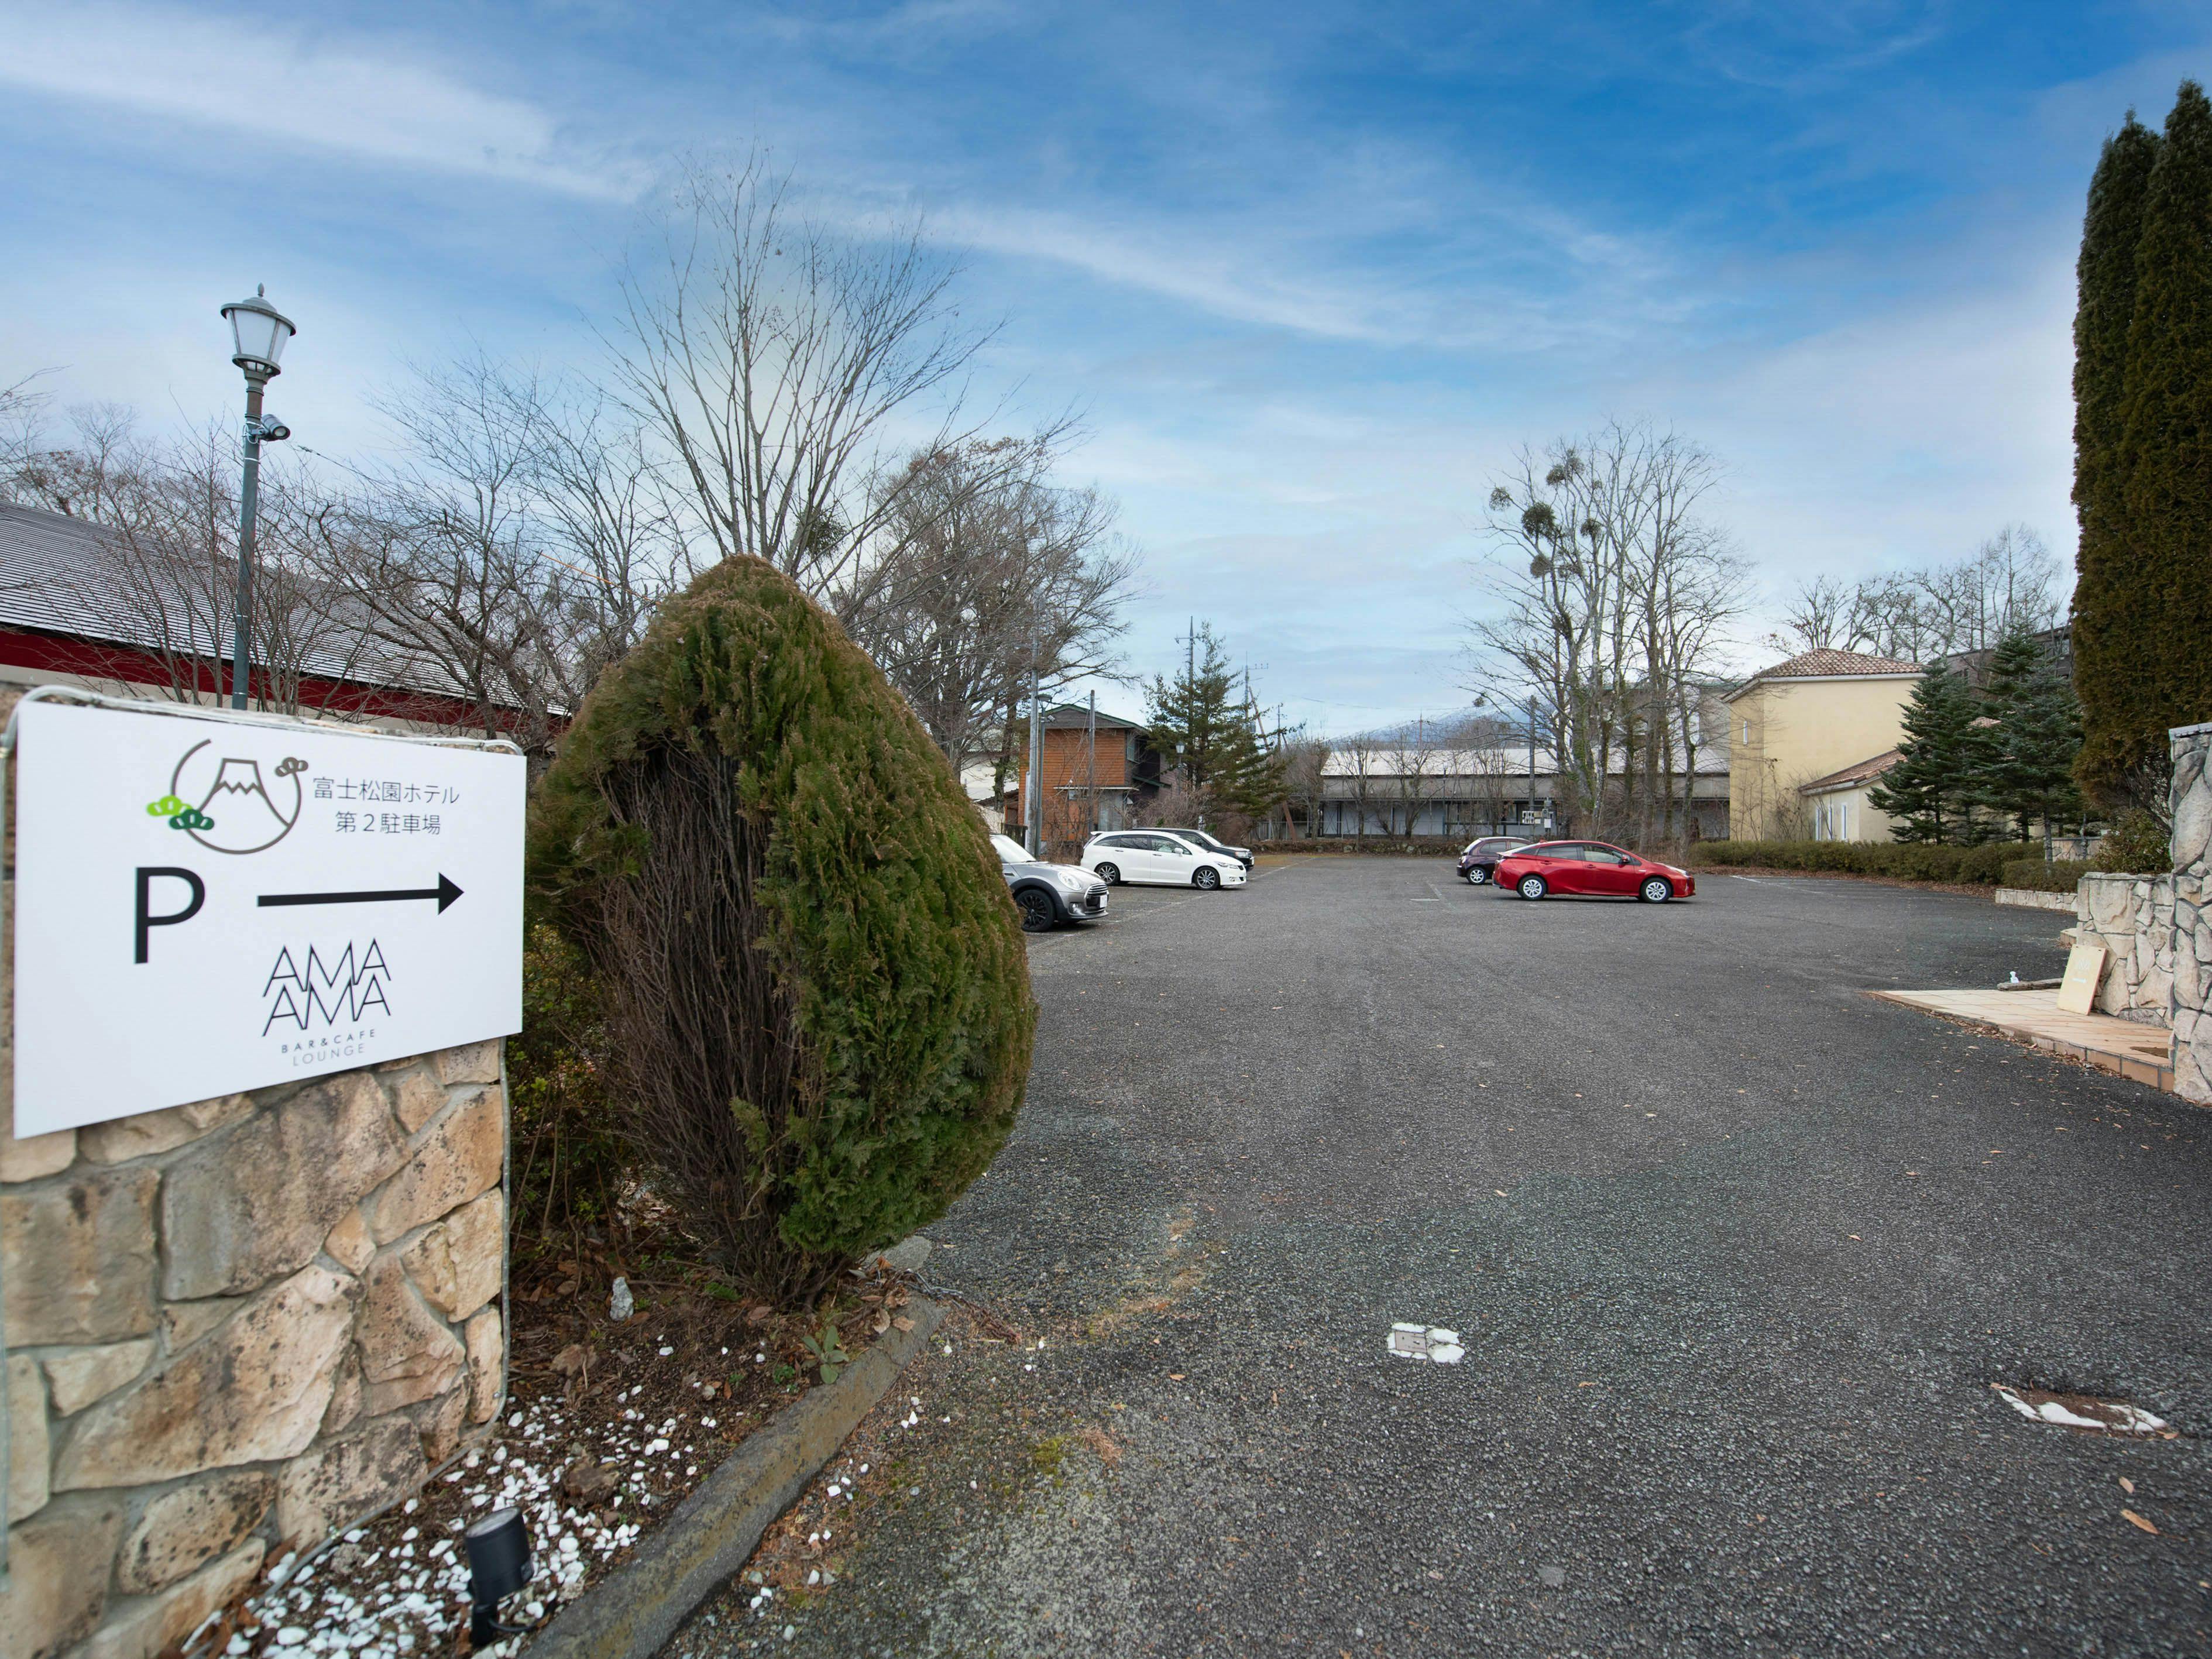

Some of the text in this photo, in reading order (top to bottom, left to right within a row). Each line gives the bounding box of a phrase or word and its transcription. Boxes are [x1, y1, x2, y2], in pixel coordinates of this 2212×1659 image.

[313, 776, 459, 803] 富士松園ホテル
[336, 811, 441, 835] 第2駐車場
[135, 867, 205, 964] P
[262, 938, 391, 997] AMA
[262, 973, 391, 1037] AMA
[281, 1029, 375, 1054] BAR&CAFE
[293, 1043, 365, 1066] LOUNGE
